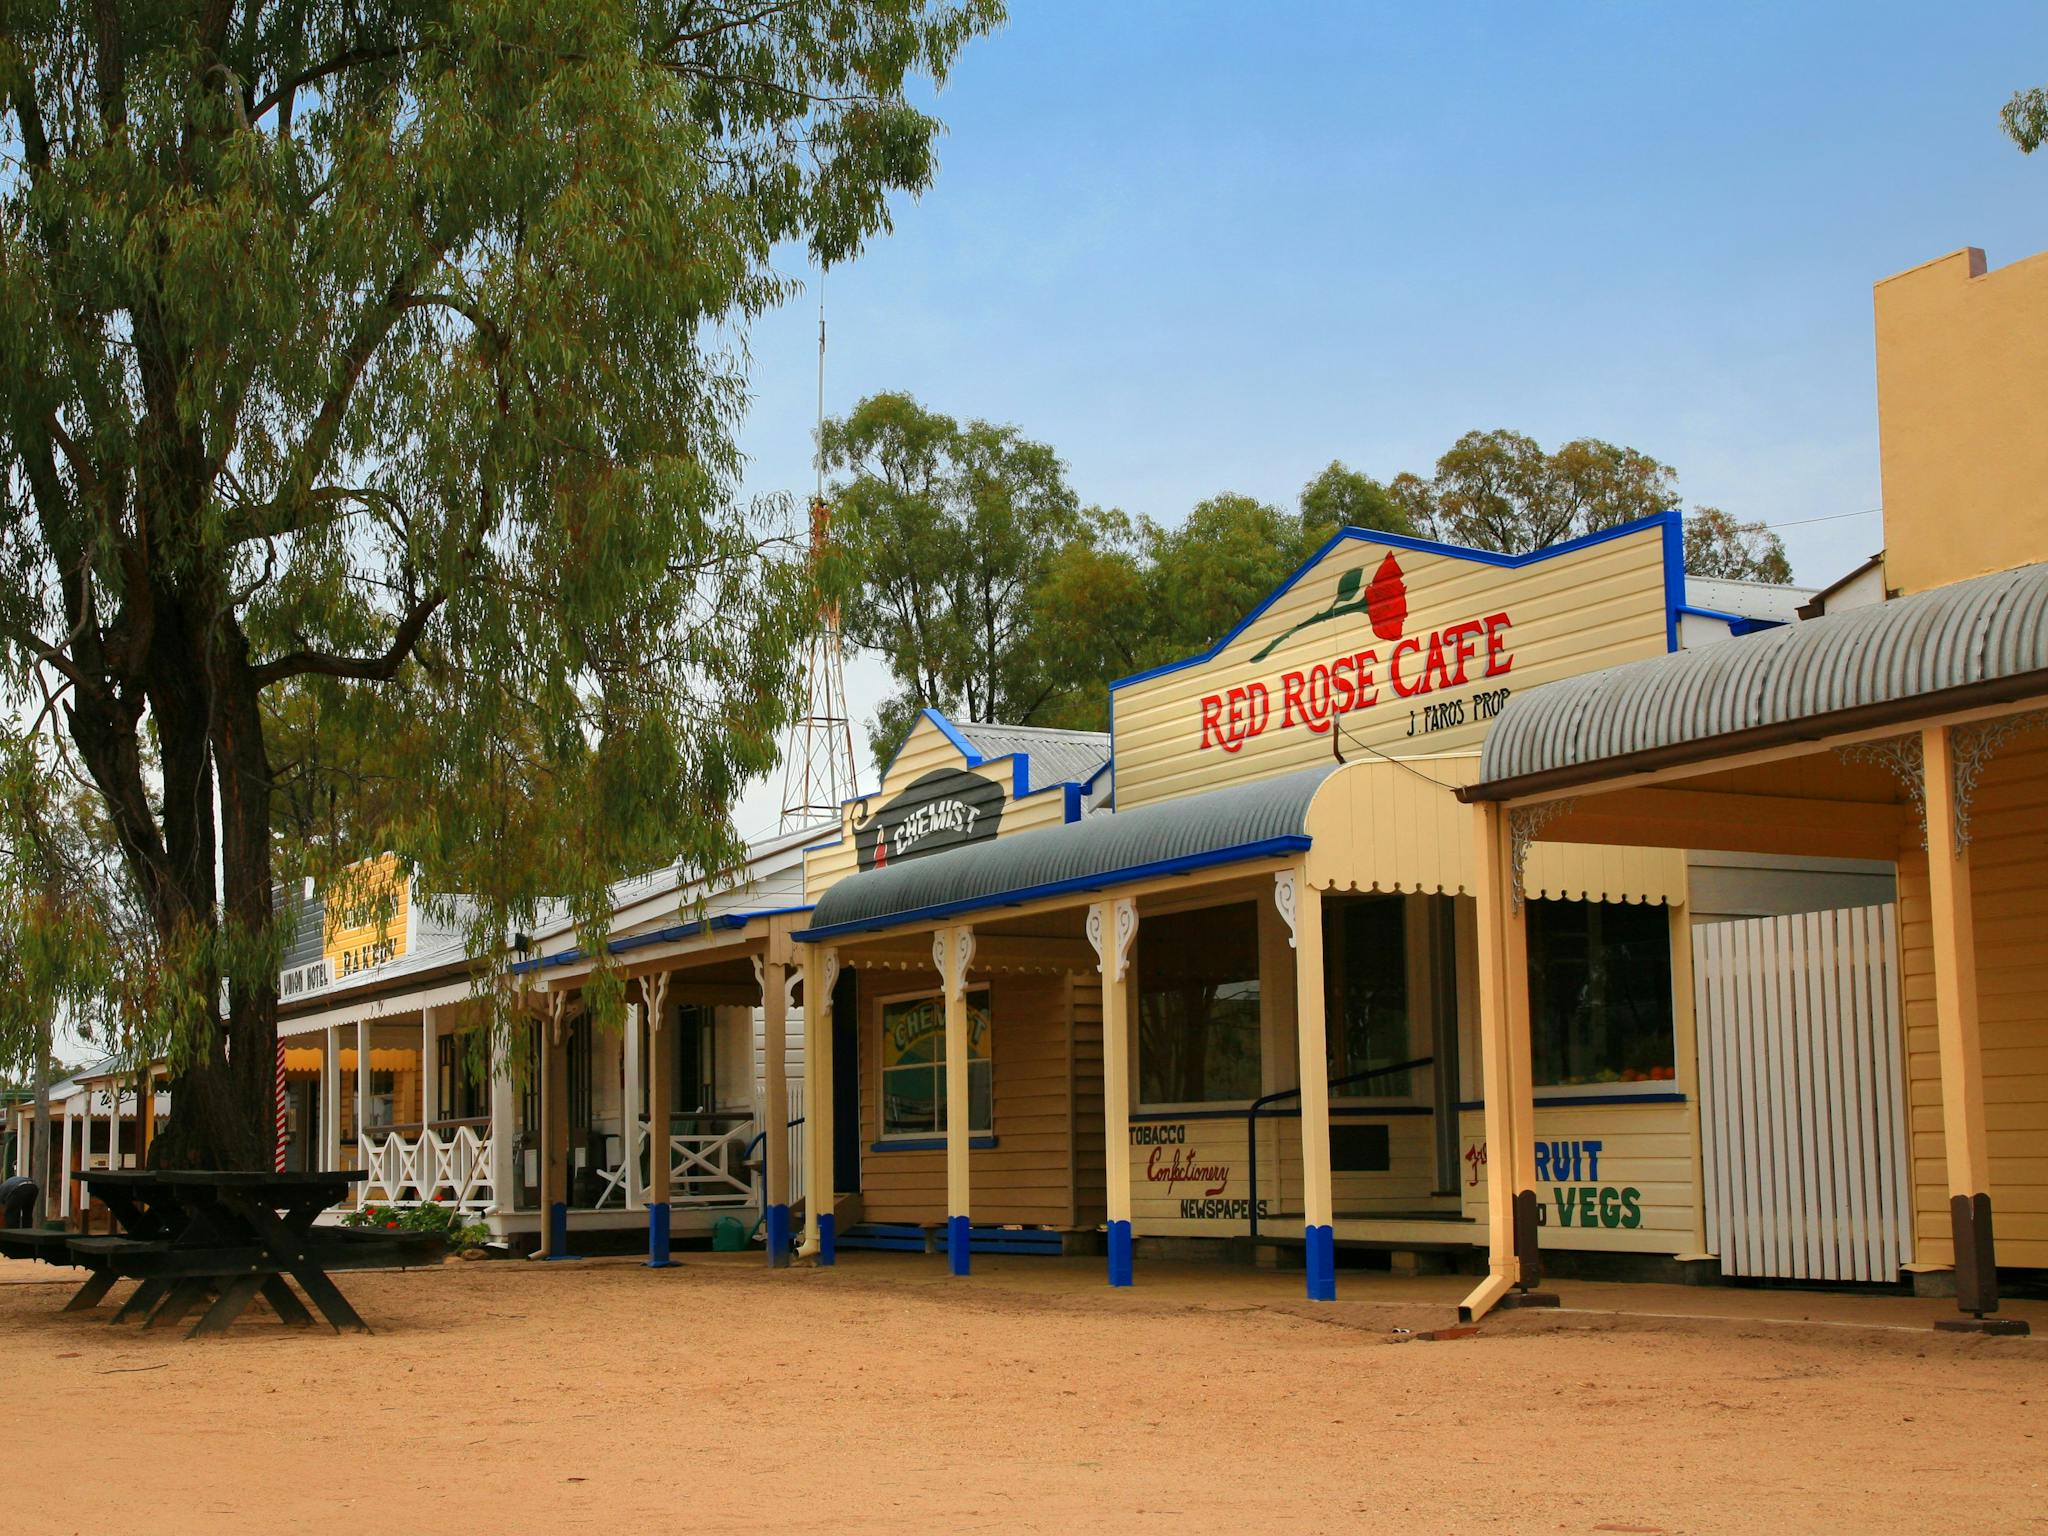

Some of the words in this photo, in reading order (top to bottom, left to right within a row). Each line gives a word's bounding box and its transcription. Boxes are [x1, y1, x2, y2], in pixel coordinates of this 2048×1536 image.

[1200, 682, 1269, 752] RED
[1281, 650, 1379, 733] ROSE
[1390, 612, 1514, 698] CAFE
[1424, 699, 1464, 733] FAROS
[894, 800, 980, 855] CHEMIST
[283, 970, 303, 995] UNION
[306, 963, 328, 990] HOTEL
[895, 1003, 987, 1051] CHEMT
[1129, 1125, 1185, 1145] TOBACCO
[1147, 1146, 1229, 1196] Confectionery
[1535, 1140, 1602, 1181] RUIT
[1180, 1199, 1267, 1219] NEWSPAPES
